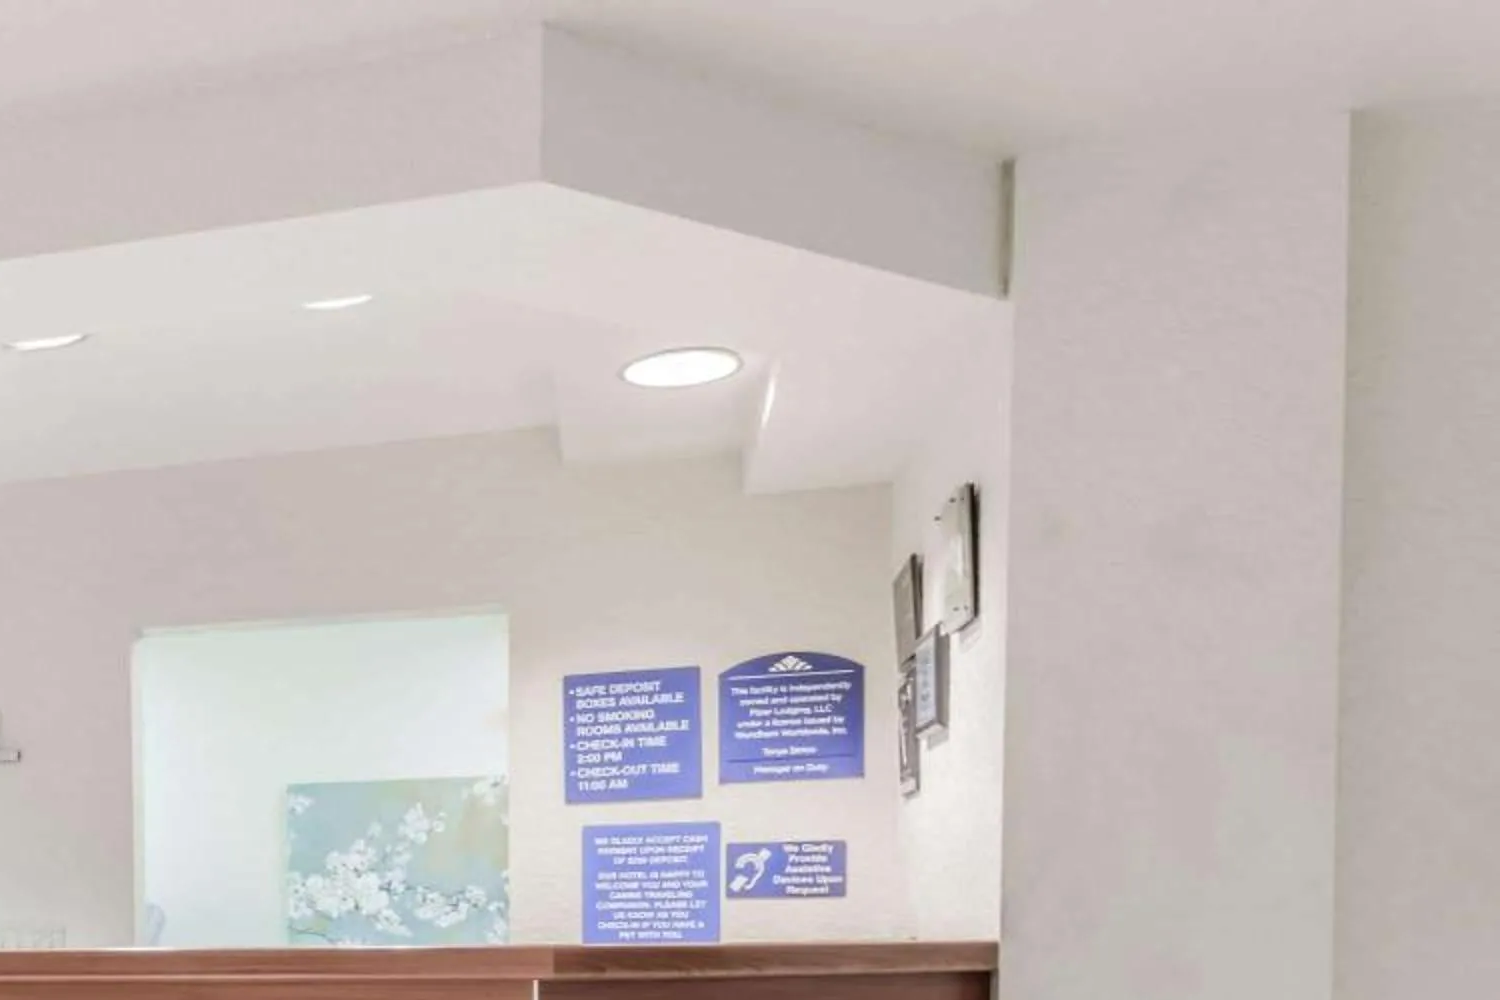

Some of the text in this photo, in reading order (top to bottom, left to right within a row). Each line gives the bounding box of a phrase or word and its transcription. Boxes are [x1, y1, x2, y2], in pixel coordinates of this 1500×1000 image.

[576, 681, 660, 697] SAFE DEPOSIT
[576, 692, 684, 709] BOXES AVAILABLE
[814, 704, 834, 712] LLC
[576, 709, 654, 723] NO SMOKING
[577, 720, 689, 736] ROOMS AVAILABLE
[577, 736, 667, 750] CHECK-IN TIME
[604, 752, 622, 761] PM
[578, 763, 679, 777] CHECK-OUT TIME
[609, 779, 628, 789] AM
